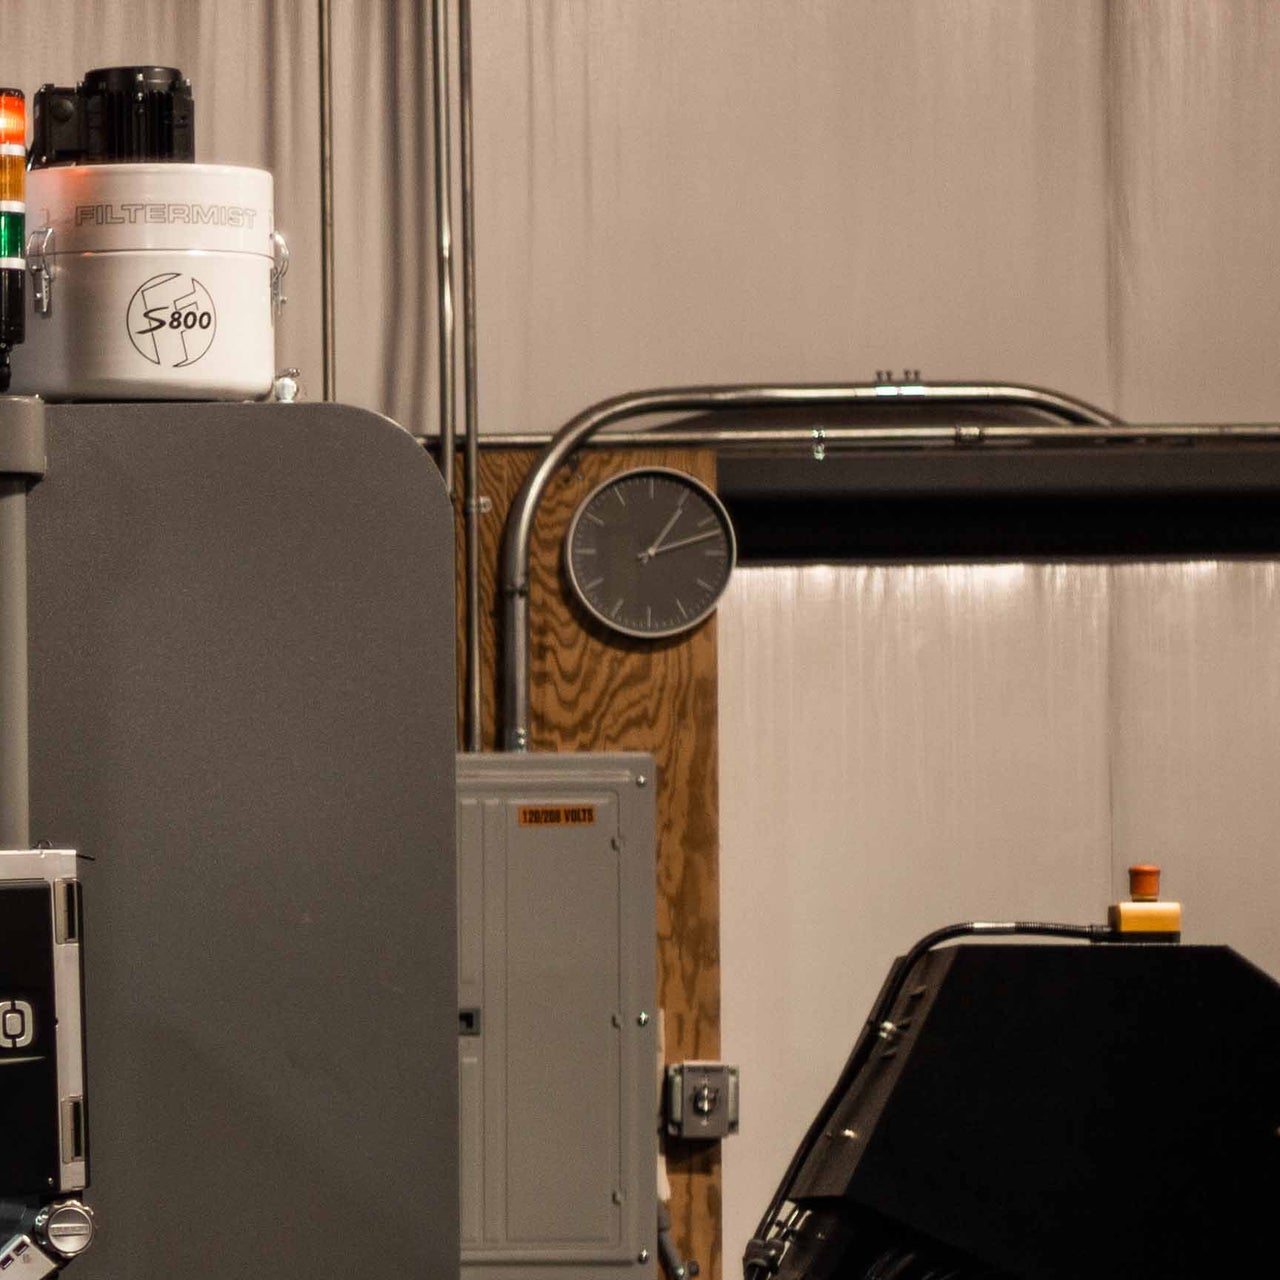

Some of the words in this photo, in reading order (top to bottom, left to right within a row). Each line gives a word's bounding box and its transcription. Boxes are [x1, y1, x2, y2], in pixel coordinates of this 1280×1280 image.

[75, 203, 256, 230] FILTERMIST
[135, 306, 212, 334] S800
[564, 808, 594, 823] VOLTS
